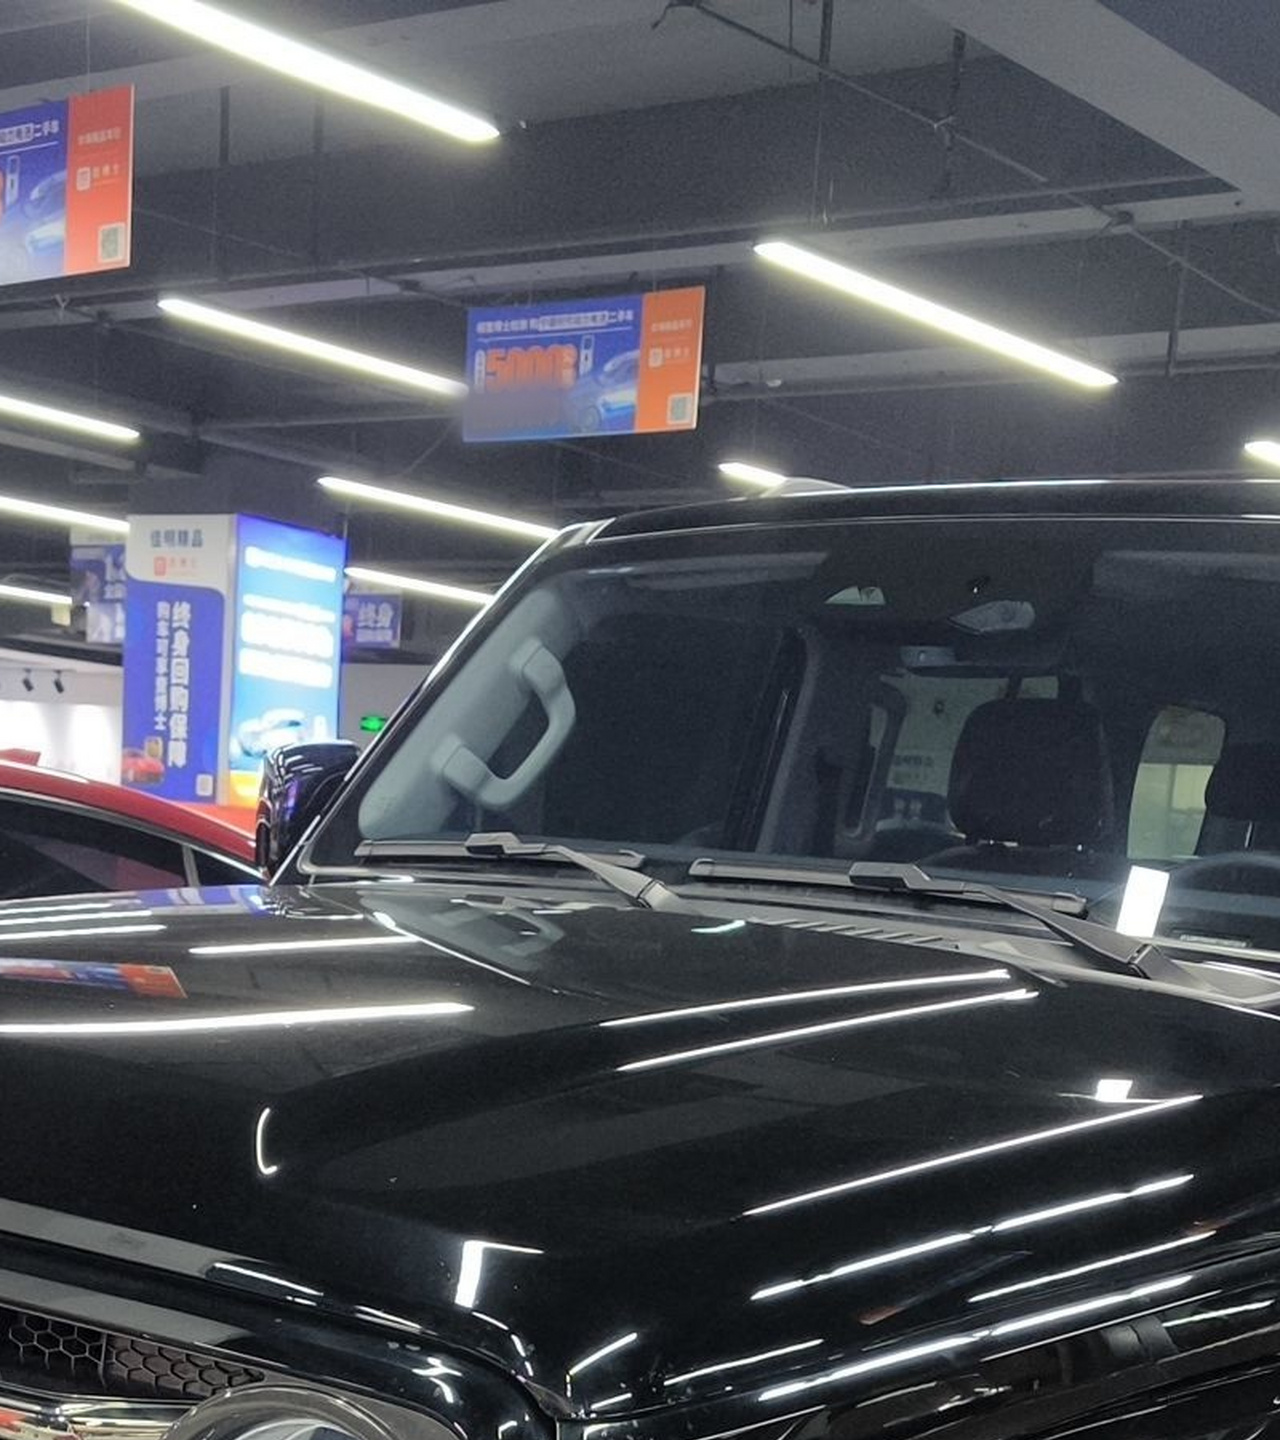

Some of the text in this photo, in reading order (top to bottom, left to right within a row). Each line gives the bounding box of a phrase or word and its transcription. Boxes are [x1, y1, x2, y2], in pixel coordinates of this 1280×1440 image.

[168, 600, 192, 768] 终身回购保障
